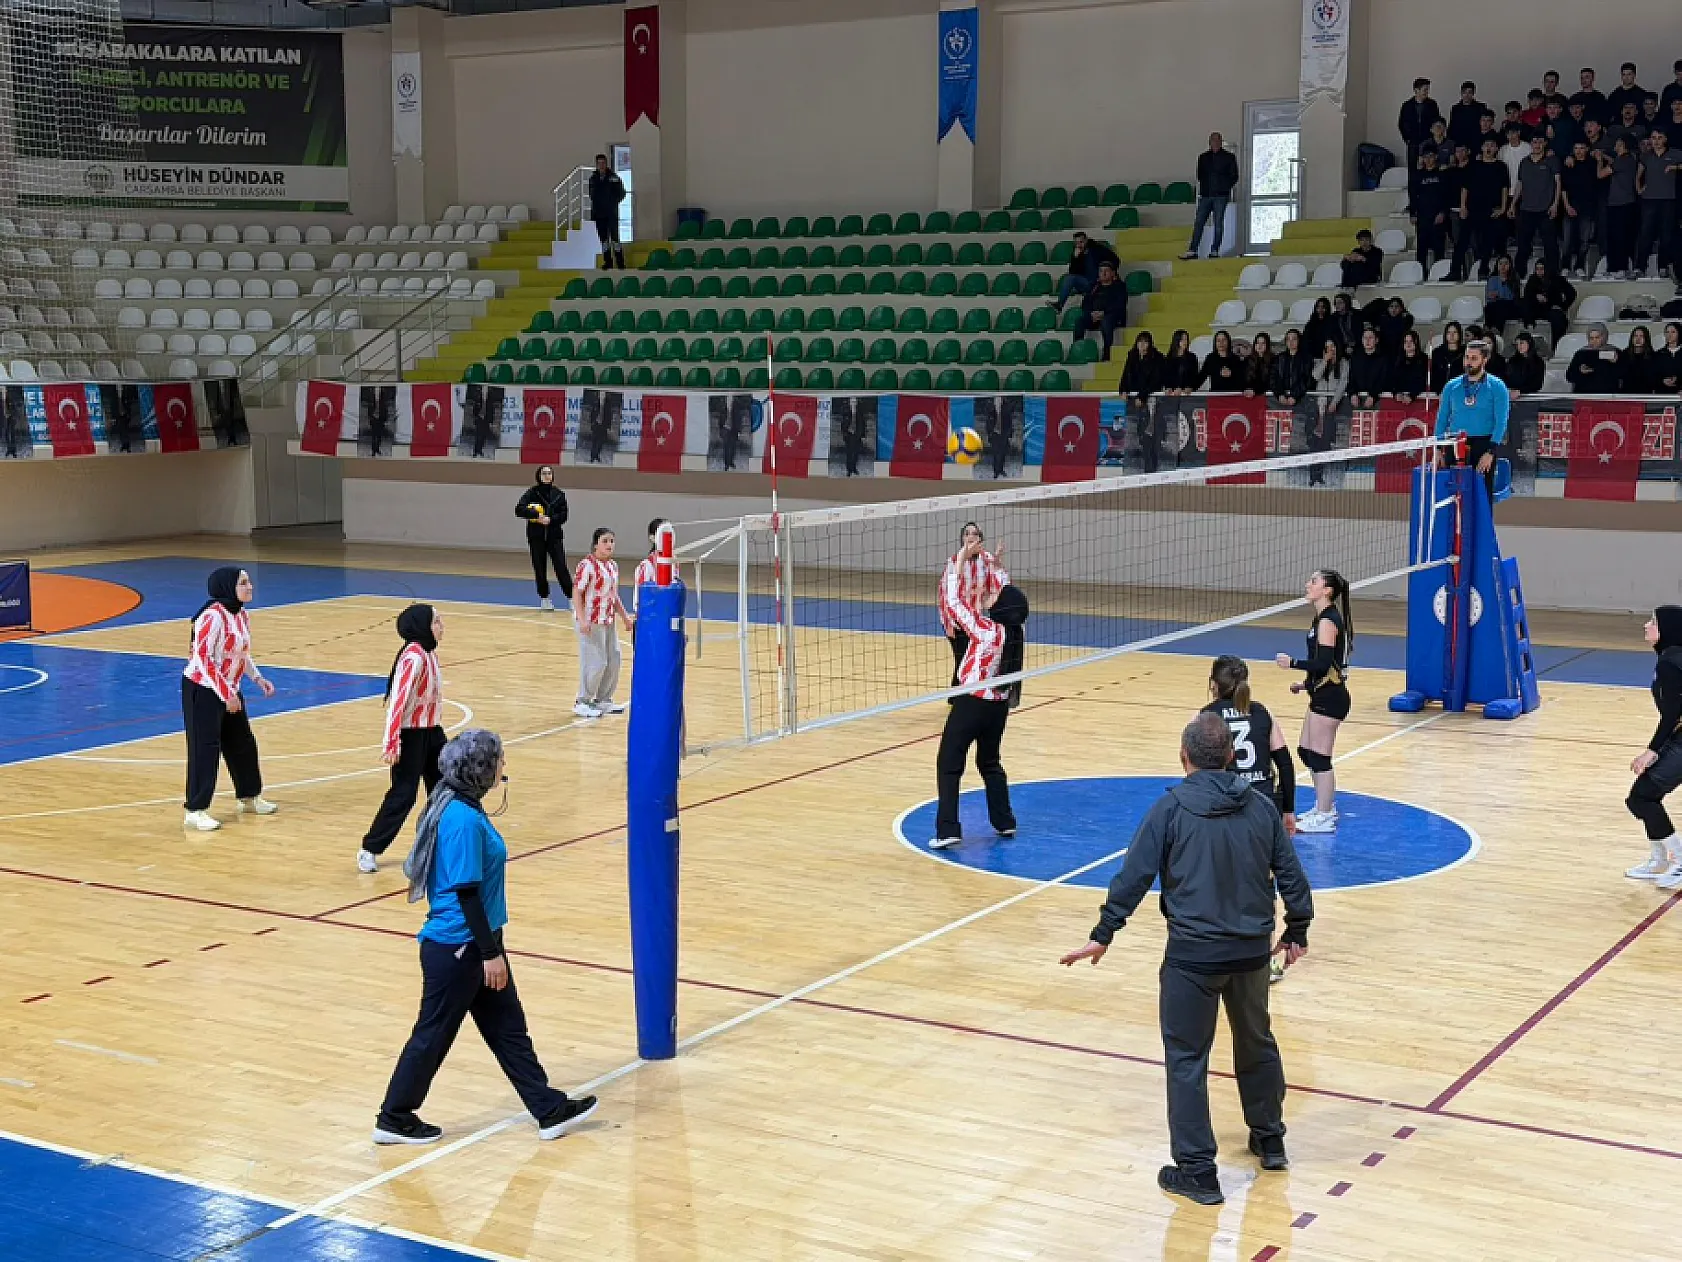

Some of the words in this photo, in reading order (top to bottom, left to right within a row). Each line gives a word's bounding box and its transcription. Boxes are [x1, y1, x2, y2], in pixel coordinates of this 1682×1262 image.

[220, 47, 301, 65] KATILAN
[156, 69, 261, 89] ANTRENÖR
[264, 73, 290, 89] VE
[117, 95, 246, 114] SPORCULARA
[196, 124, 267, 146] Dilerim
[123, 165, 203, 183] HÜSEYİN
[208, 167, 286, 185] DÜNDAR
[1228, 720, 1256, 769] 3
